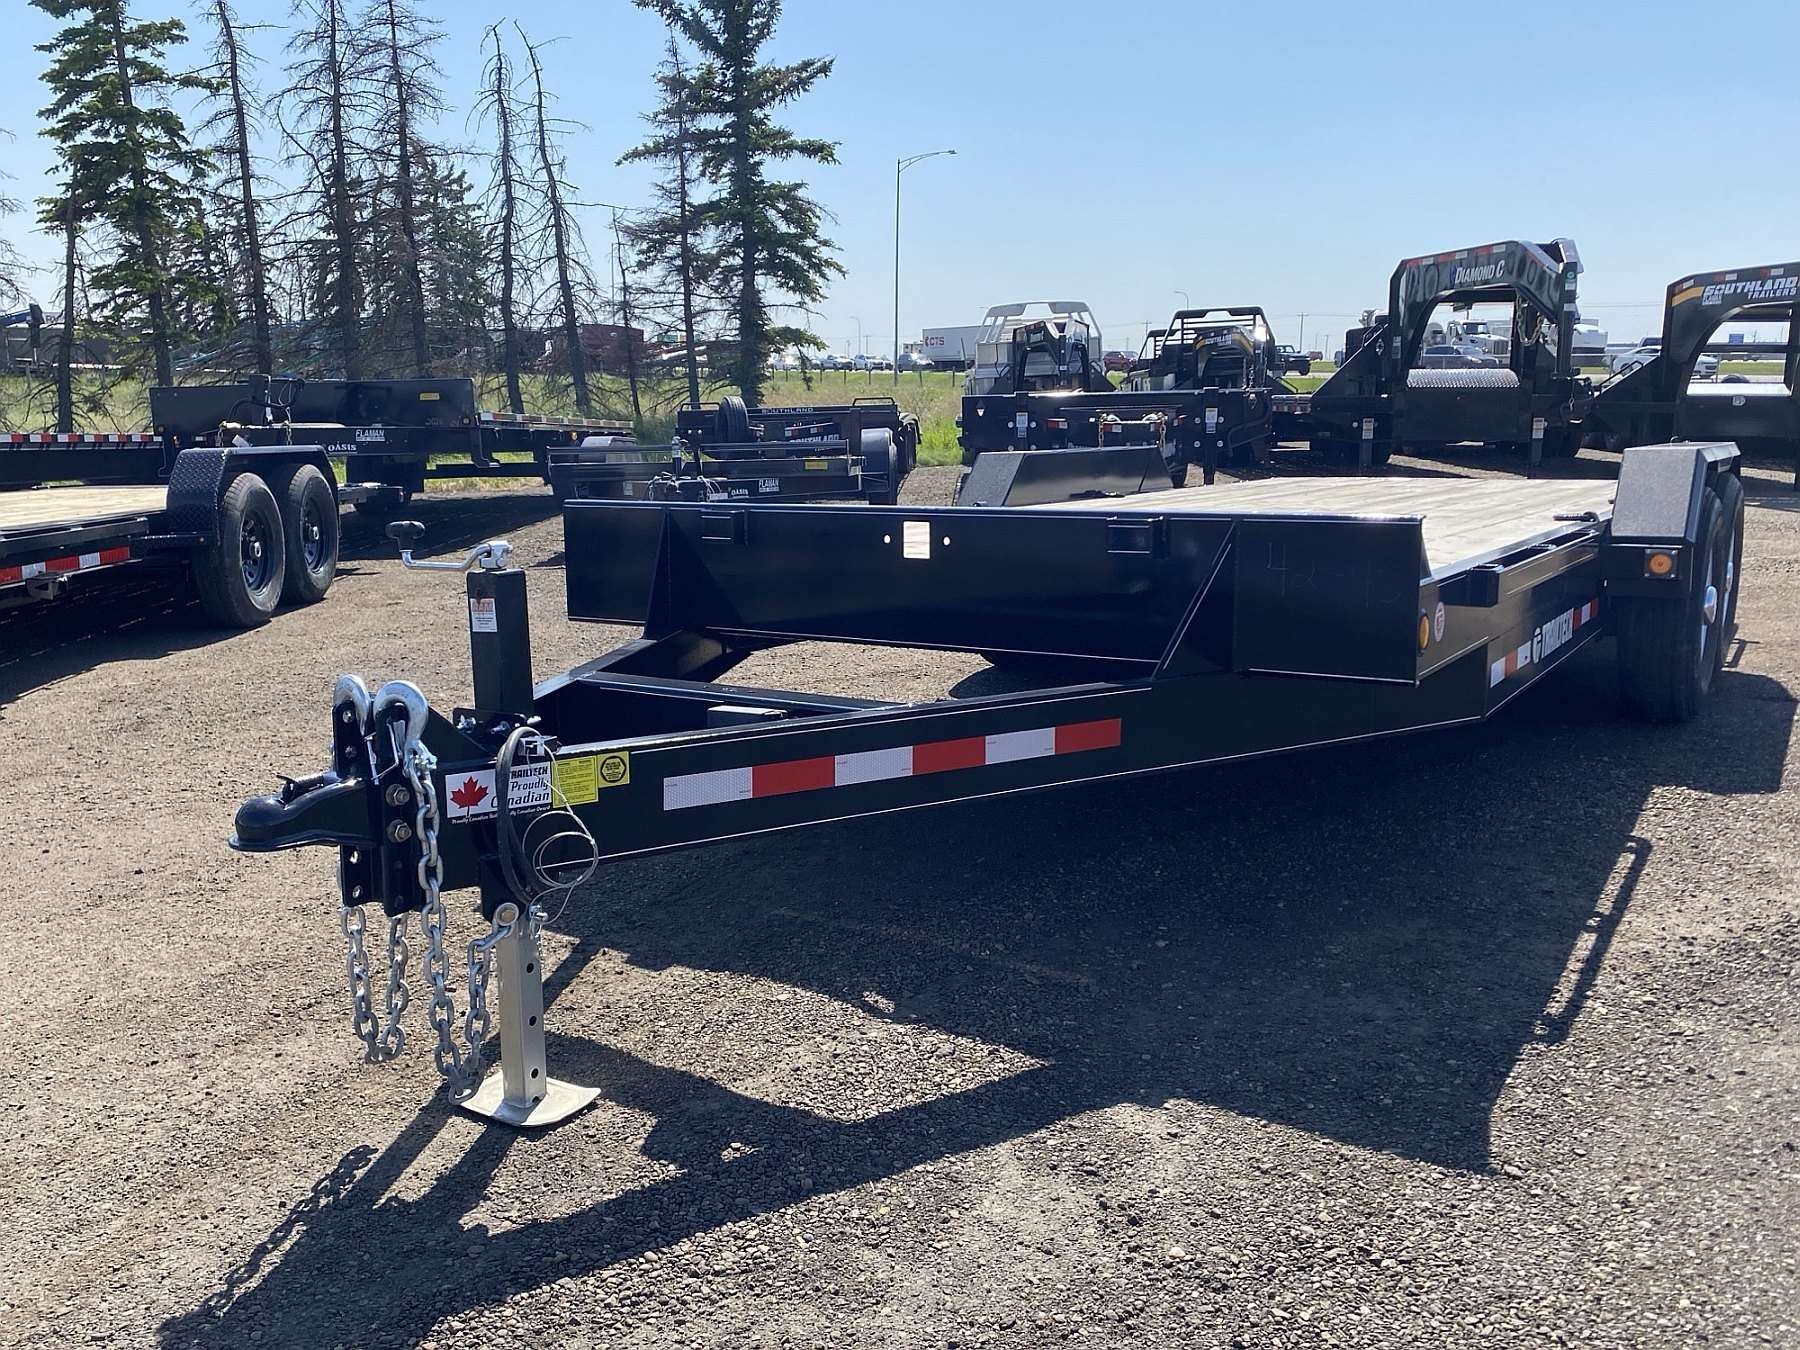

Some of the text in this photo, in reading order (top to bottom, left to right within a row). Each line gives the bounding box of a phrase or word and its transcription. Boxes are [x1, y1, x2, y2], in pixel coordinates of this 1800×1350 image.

[1455, 260, 1505, 284] DIAMOND C
[1703, 276, 1799, 295] SOUTHLAND
[1747, 287, 1797, 300] TRAILERS
[929, 336, 945, 346] CTS
[356, 429, 385, 438] FLAMAN
[327, 441, 357, 452] OASIS
[759, 478, 779, 488] FLAMAN
[731, 488, 749, 496] OASIS
[510, 766, 548, 779] RAILTECH
[510, 778, 550, 792] Proudly
[491, 791, 550, 808] Cnadian
